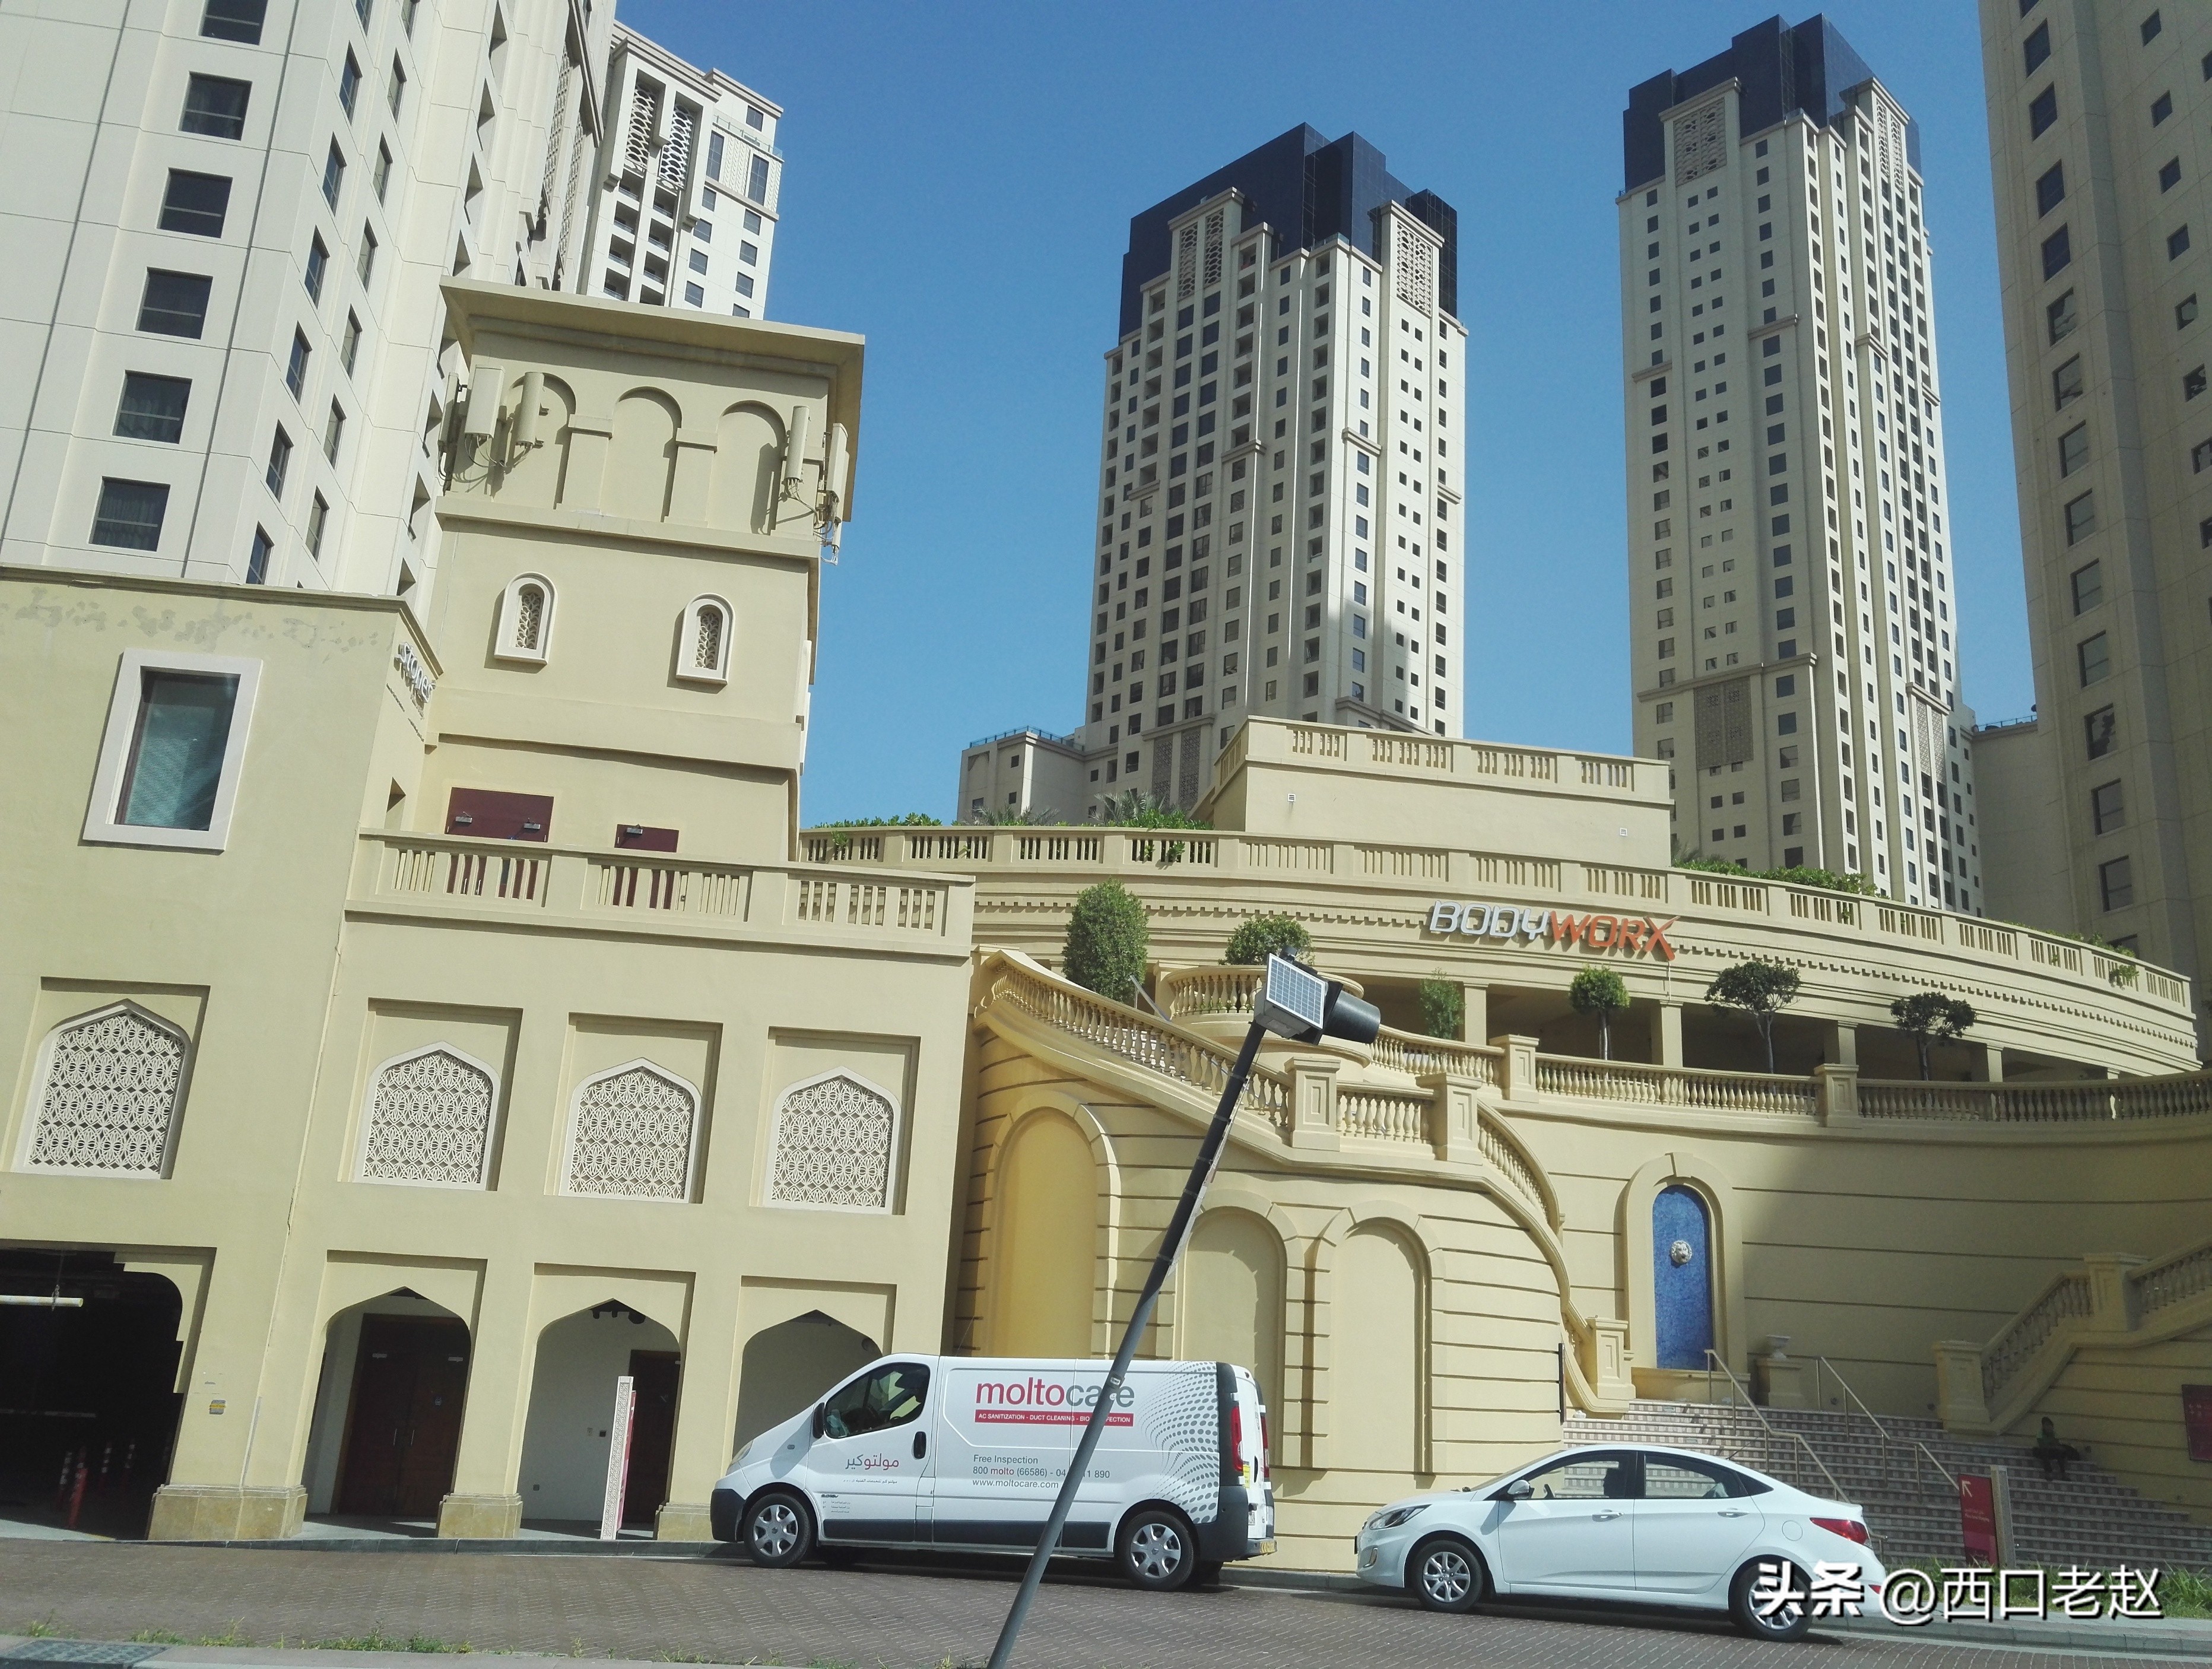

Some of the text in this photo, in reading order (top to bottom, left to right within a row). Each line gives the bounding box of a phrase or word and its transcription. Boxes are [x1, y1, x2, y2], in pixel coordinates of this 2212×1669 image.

[976, 1377, 1135, 1407] moltocae
[973, 1455, 1038, 1465] Free Inspection
[1017, 1468, 1048, 1478] (66586)
[1094, 1470, 1110, 1478] 890
[972, 1479, 1059, 1489] www.moltocare.com
